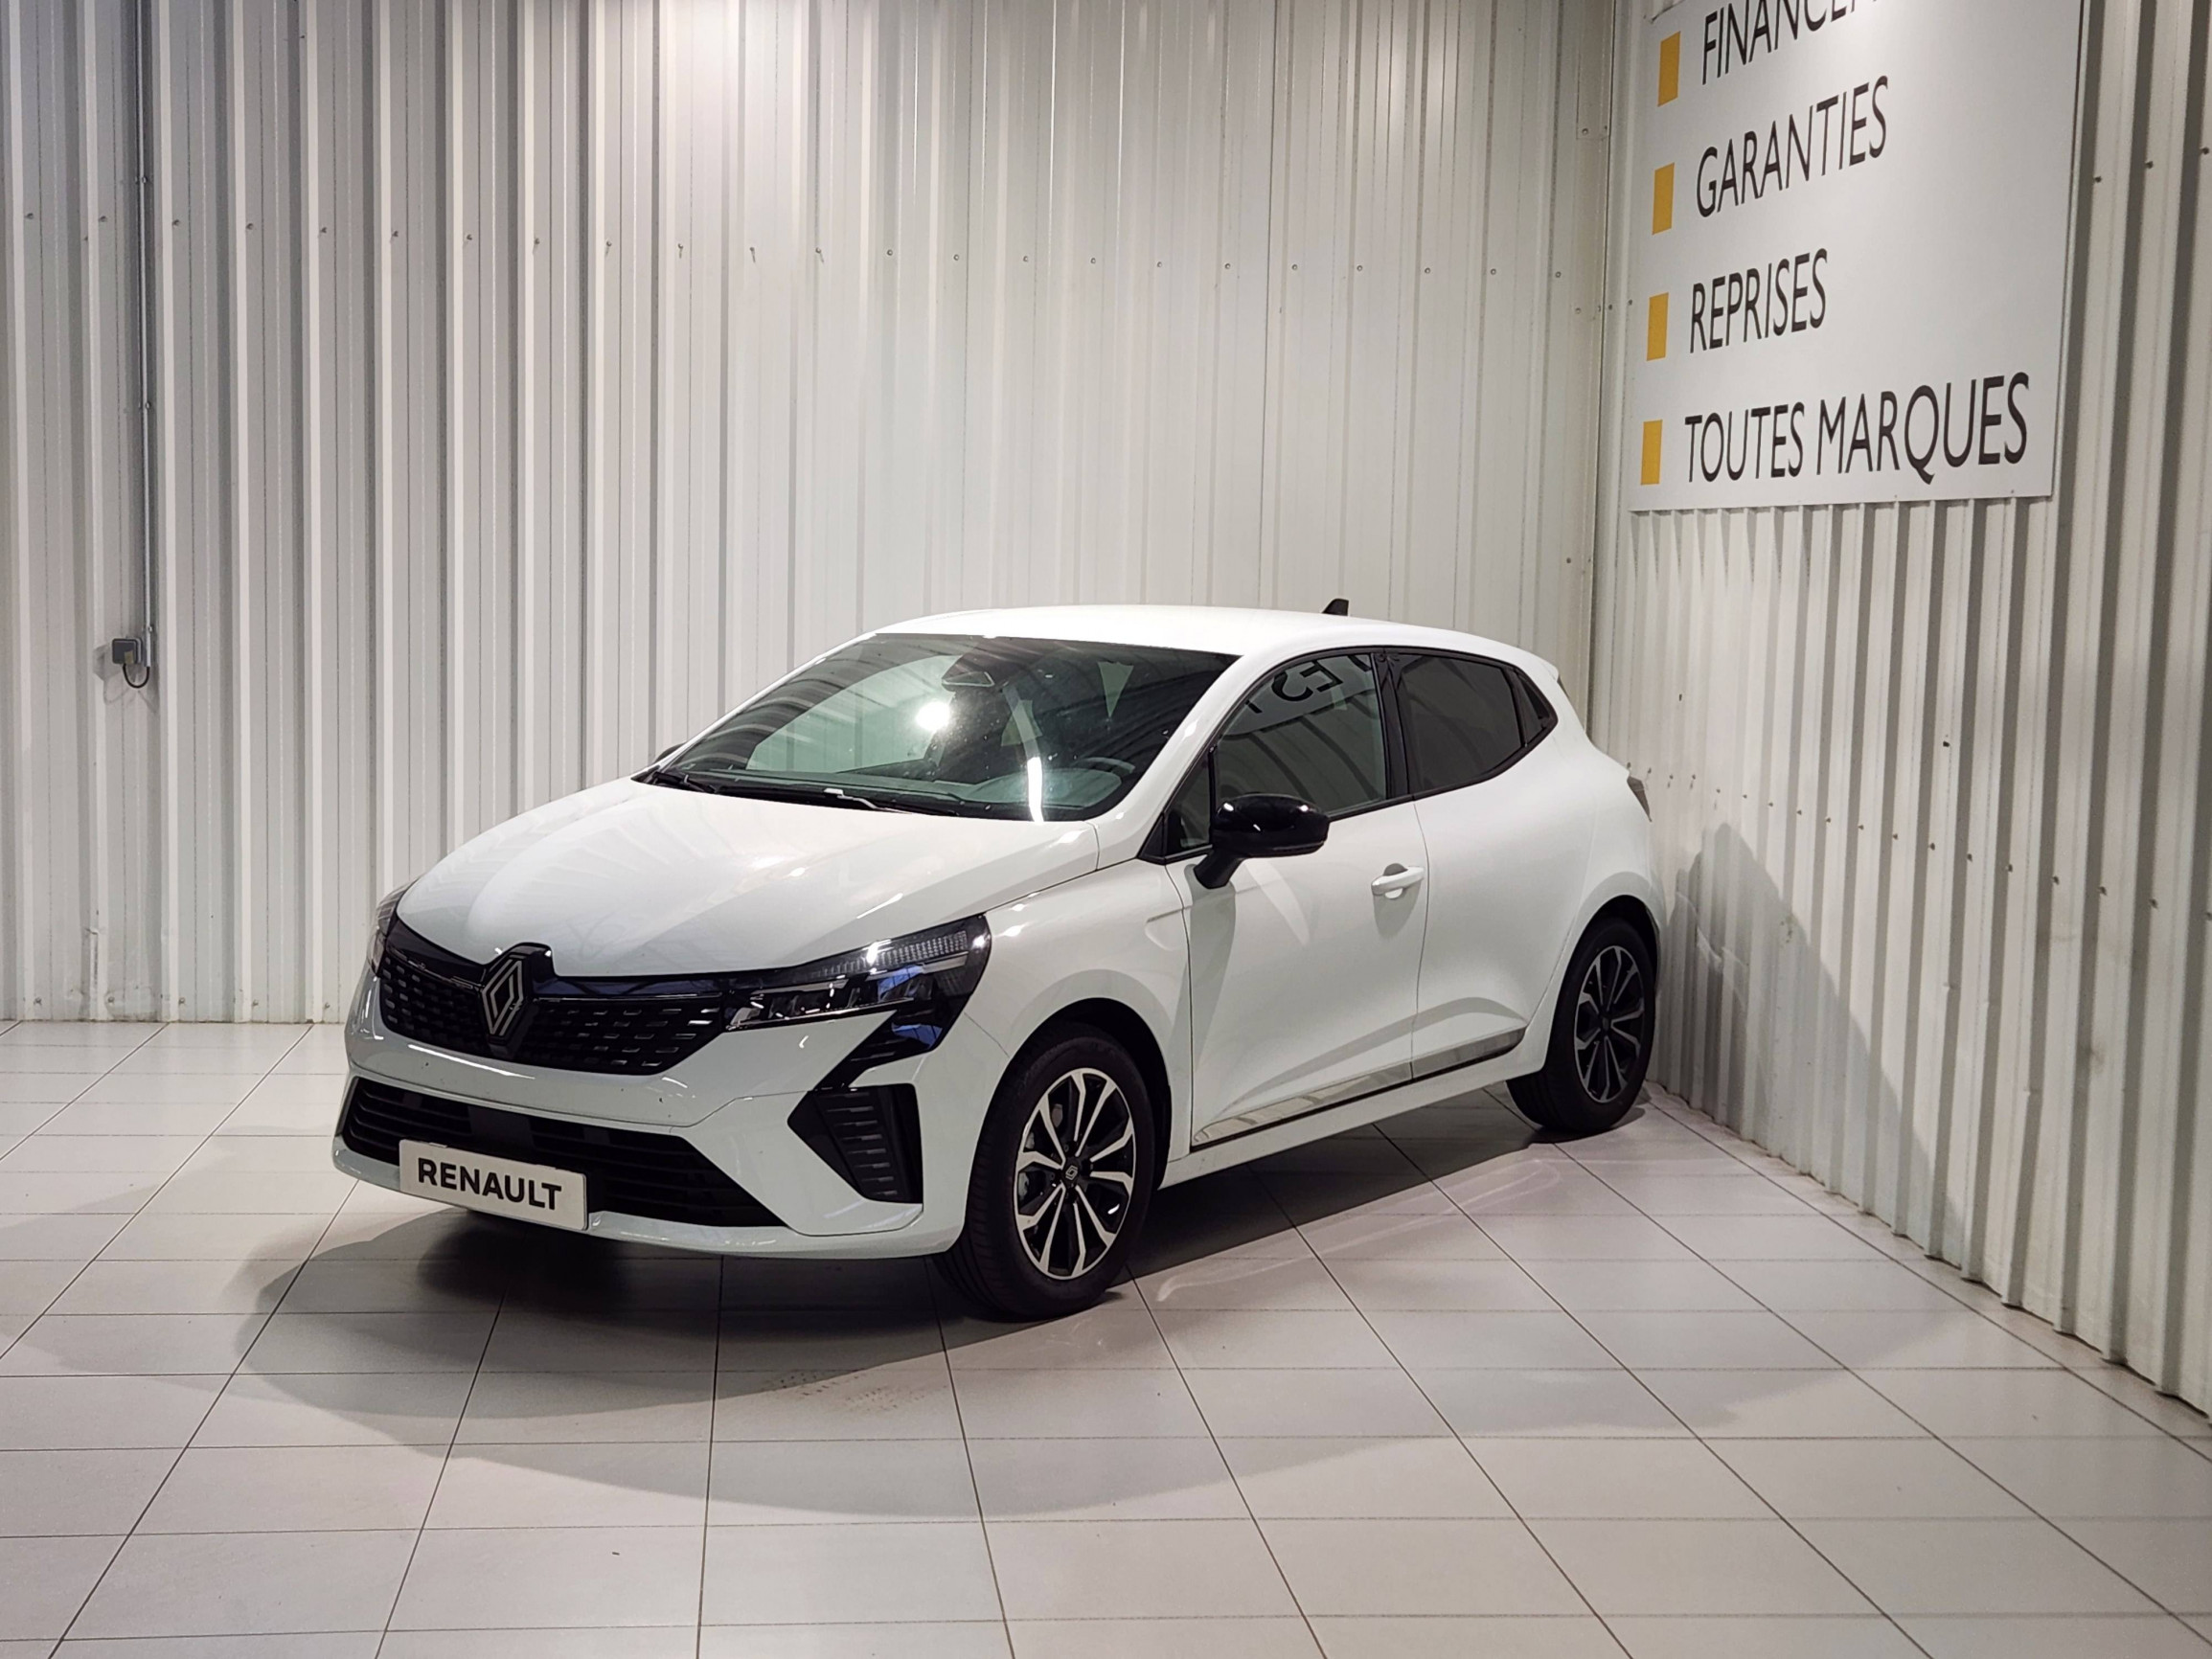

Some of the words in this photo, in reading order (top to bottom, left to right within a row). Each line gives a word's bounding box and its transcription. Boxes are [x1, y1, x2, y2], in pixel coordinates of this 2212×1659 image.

[1696, 75, 1889, 218] GARANTIES
[1689, 248, 1829, 354] REPRISES
[1684, 401, 1805, 484] TOUTES
[1816, 371, 2030, 486] MARQUES
[418, 1156, 562, 1211] RENAULT
